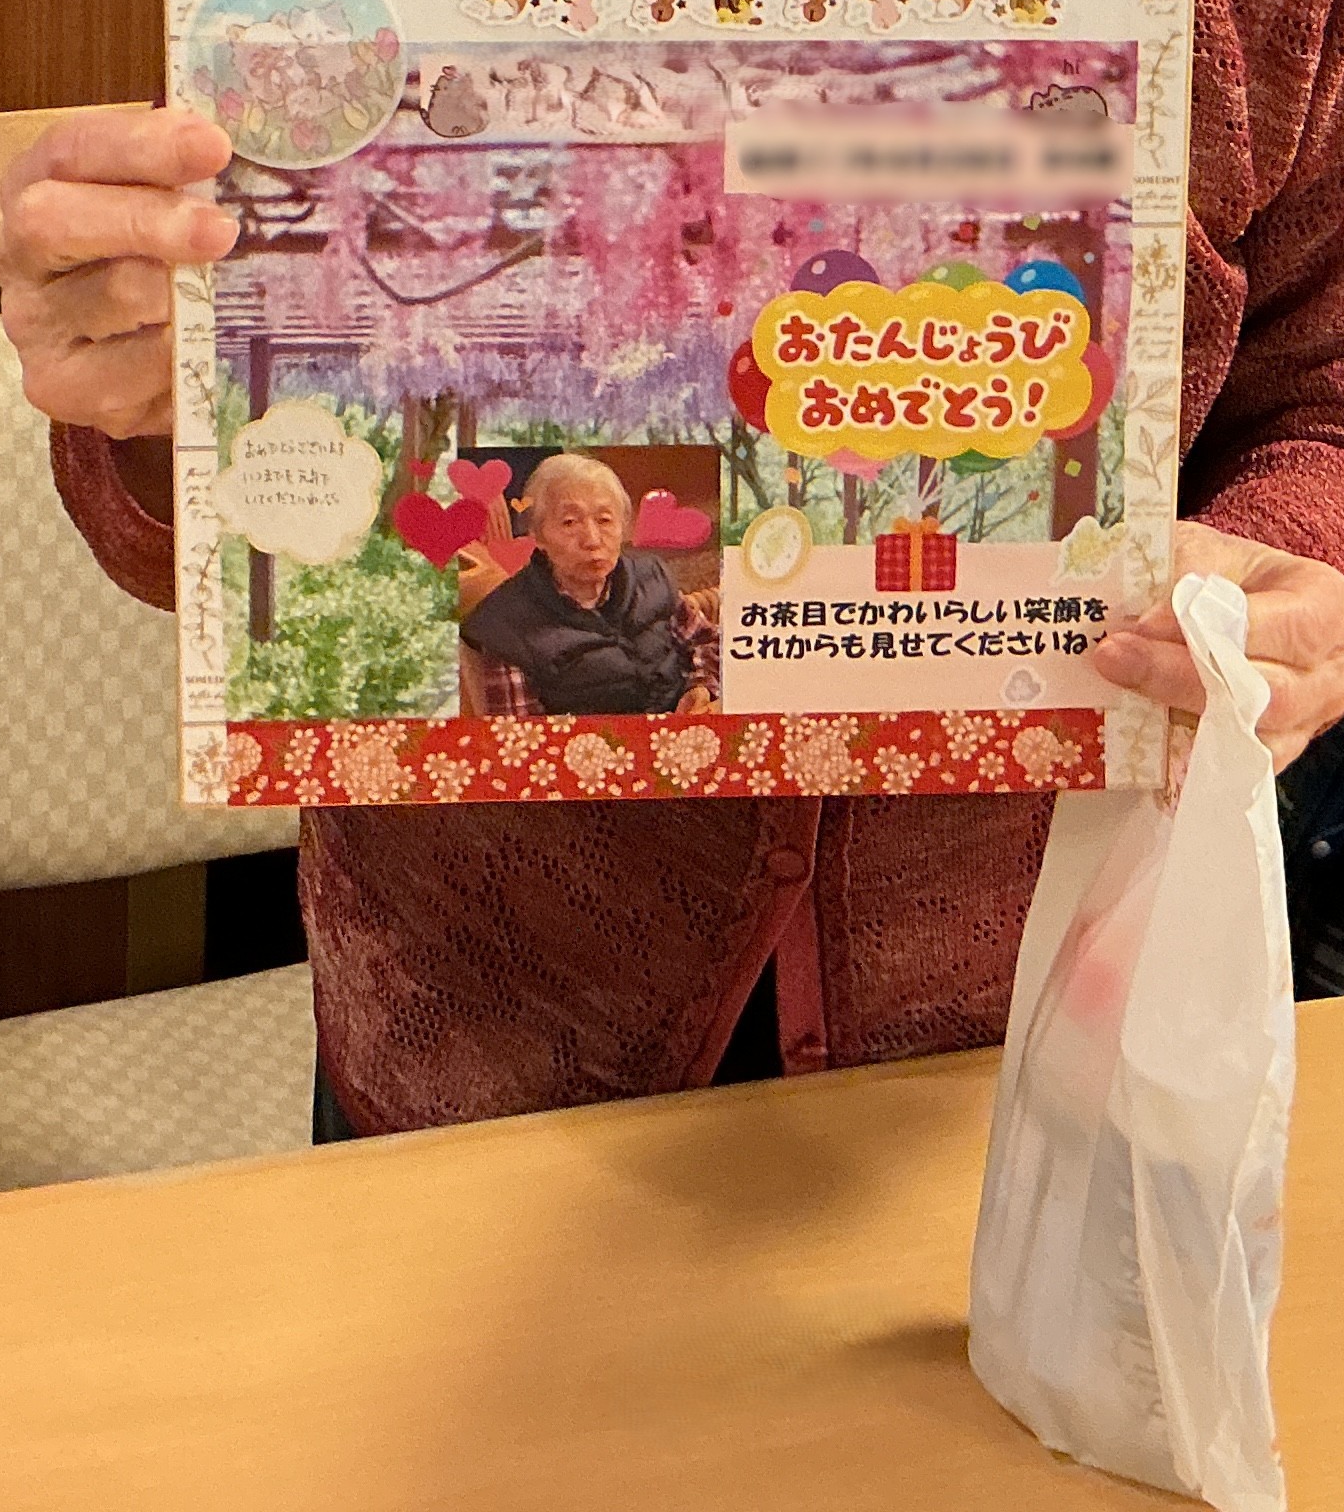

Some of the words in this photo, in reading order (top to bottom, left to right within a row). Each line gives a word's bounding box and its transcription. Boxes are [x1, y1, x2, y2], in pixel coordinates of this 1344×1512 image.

[778, 312, 1071, 363] おたんじょうび
[801, 377, 1044, 428] おめでとう!
[741, 596, 1109, 628] お茶目でかわいらしい笑顔を
